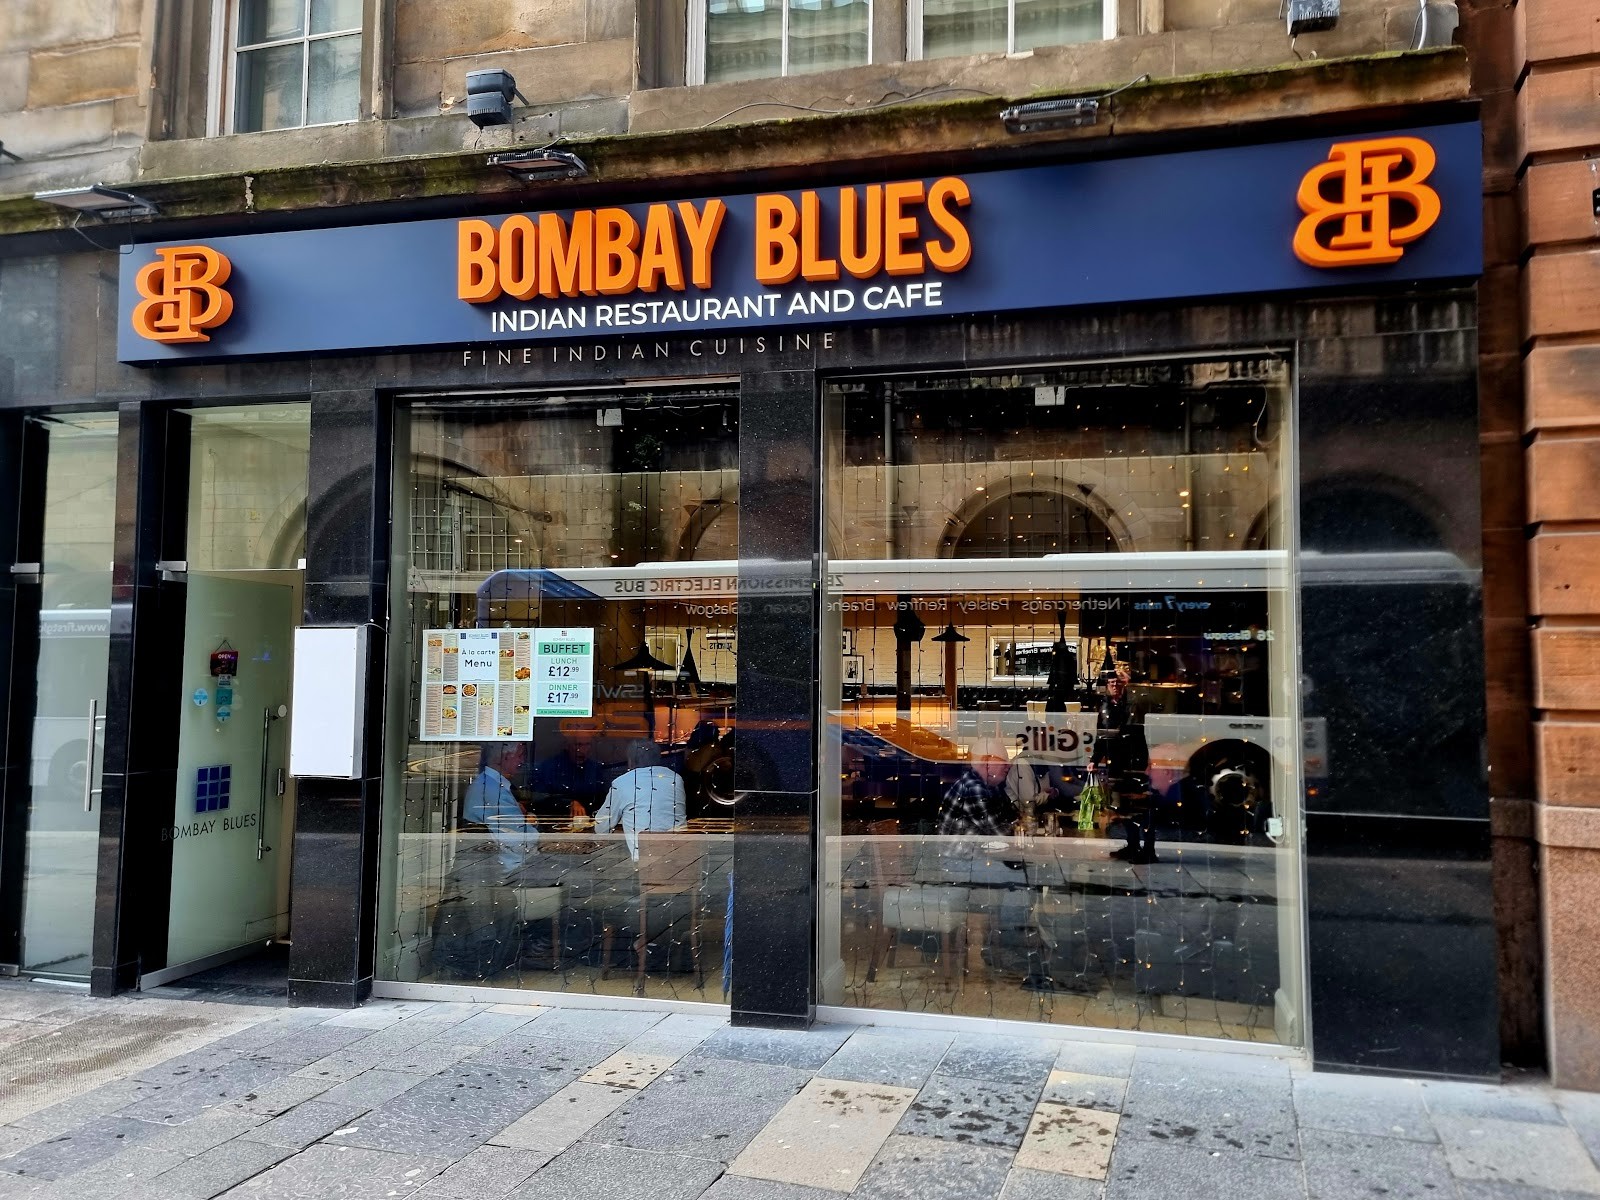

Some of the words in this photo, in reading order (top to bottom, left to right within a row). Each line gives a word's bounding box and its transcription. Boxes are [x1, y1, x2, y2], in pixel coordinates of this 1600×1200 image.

[459, 205, 726, 303] BOMBAY
[755, 177, 971, 284] BLUES
[493, 307, 585, 332] INDIAN
[597, 294, 781, 326] RESTAURANT
[788, 290, 854, 315] AND
[863, 282, 942, 310] CAFE
[462, 347, 532, 367] FINE
[552, 341, 670, 363] INDIAN
[689, 331, 836, 357] CUISINE
[543, 644, 586, 654] BUFFET
[550, 657, 578, 665] LUNCH
[464, 659, 493, 668] Menu
[161, 820, 216, 841] BOMBAY
[223, 813, 257, 831] BLUES
